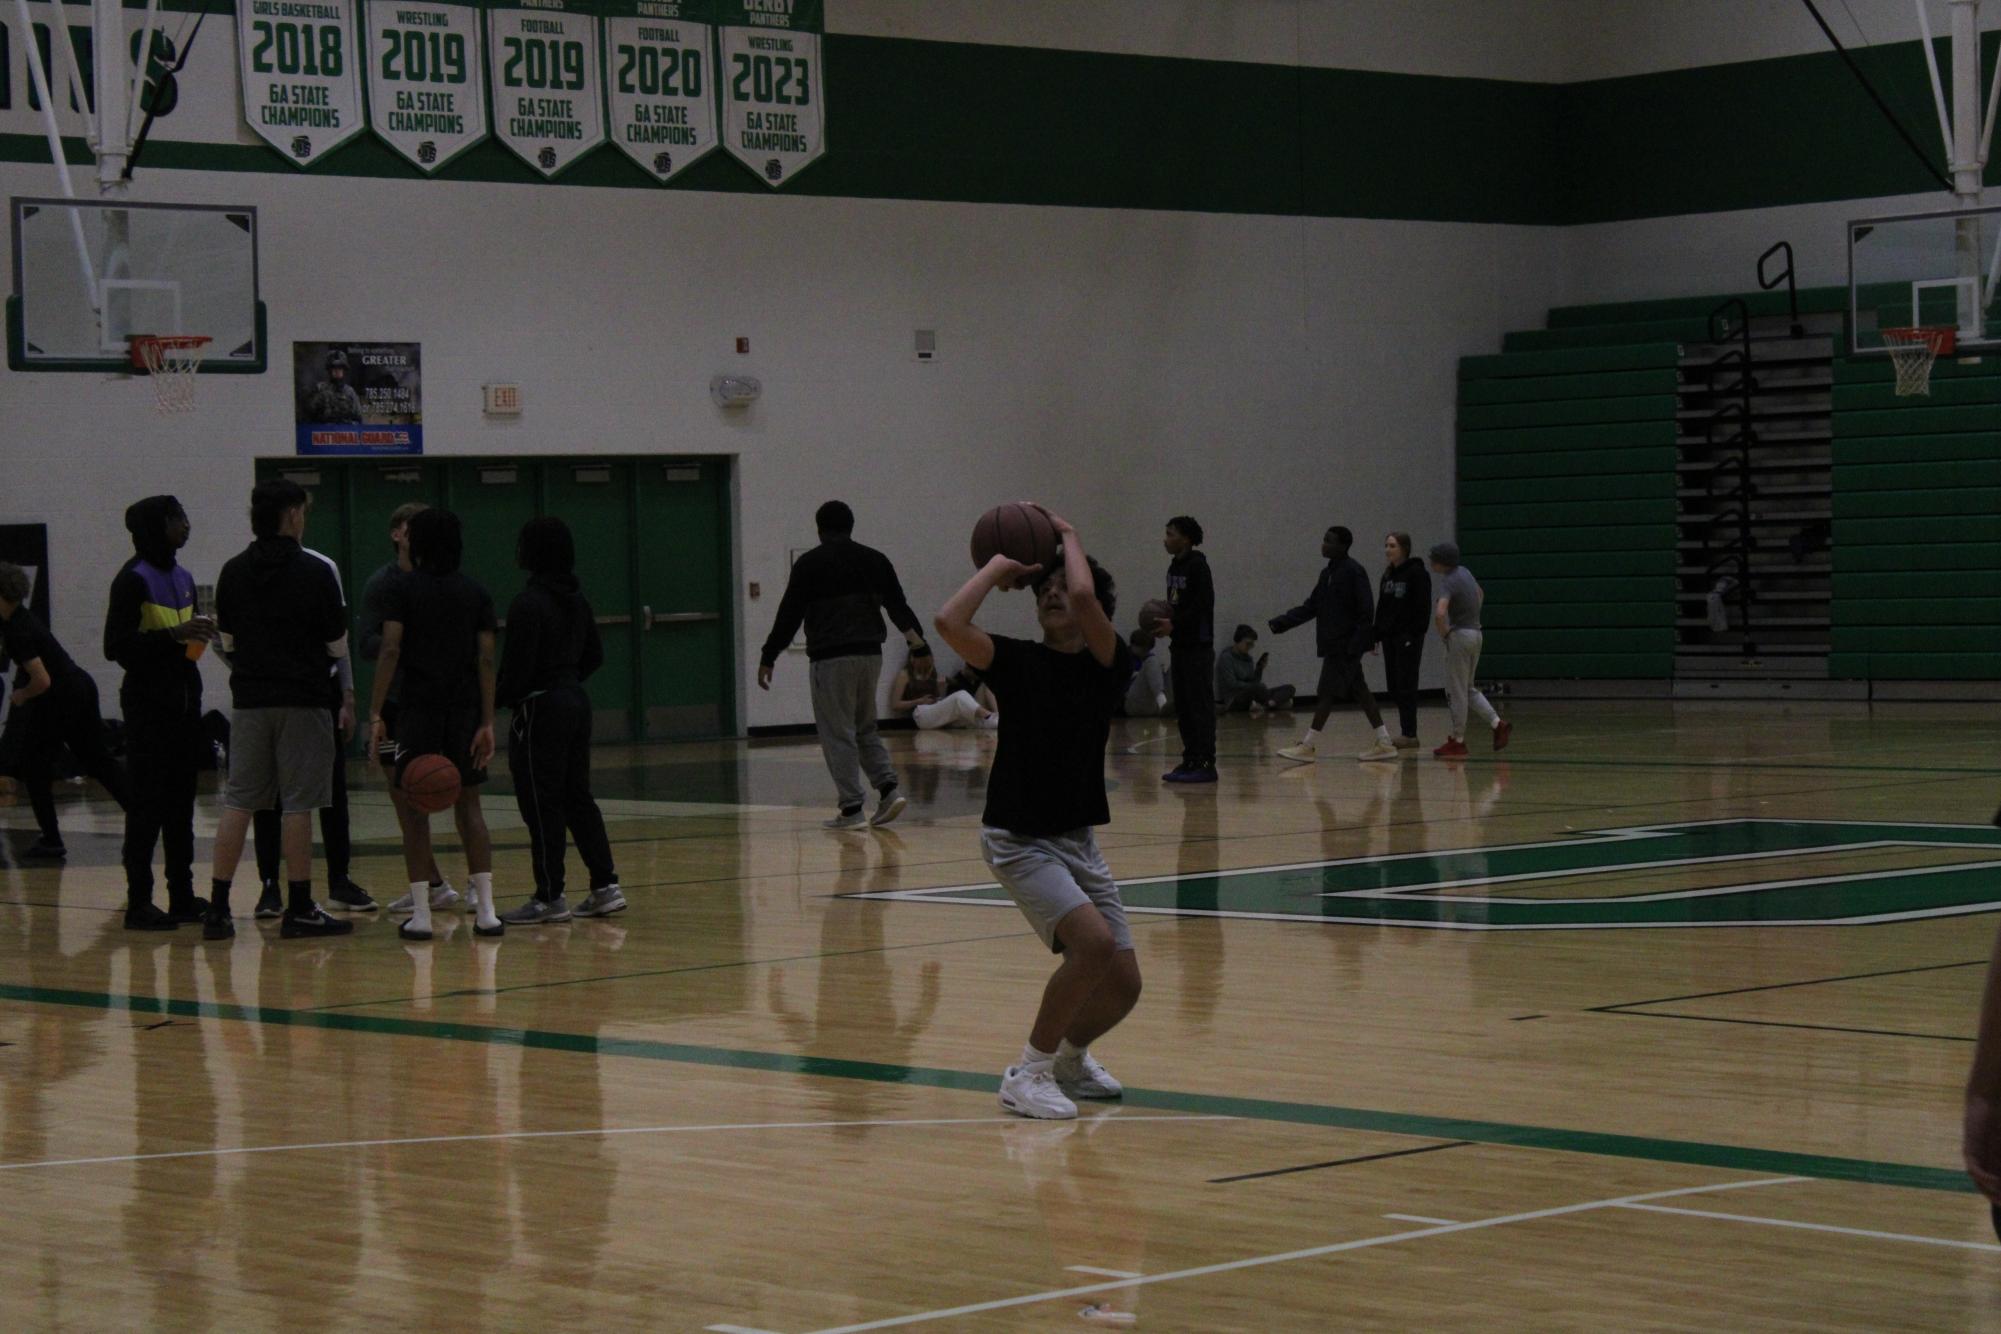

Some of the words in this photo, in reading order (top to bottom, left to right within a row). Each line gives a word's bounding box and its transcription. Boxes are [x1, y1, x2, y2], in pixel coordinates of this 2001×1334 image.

[253, 1, 279, 16] GIRLS
[281, 3, 341, 20] BASKETBALL
[397, 10, 449, 27] WRESTLING
[637, 2, 679, 17] PANTHERS
[749, 12, 790, 28] PANTHERS
[521, 19, 565, 35] FOOTBALL
[638, 27, 680, 43] FOOTBALL
[252, 20, 343, 77] 2018
[748, 36, 794, 52] WRESTLING
[381, 29, 467, 84] 2019
[504, 37, 584, 91] 2019
[618, 45, 701, 97] 2020
[733, 53, 810, 106] 2023
[269, 84, 289, 105] 6A
[292, 86, 329, 106] STATE
[396, 91, 416, 111] 6A
[418, 92, 454, 113] STATE
[261, 106, 340, 129] CHAMPIONS
[518, 97, 535, 118] 6A
[538, 99, 573, 119] STATE
[634, 105, 651, 123] 6A
[654, 105, 688, 125] STATE
[388, 112, 464, 135] CHAMPIONS
[510, 118, 583, 140] CHAMPIONS
[746, 111, 763, 130] 6A
[765, 113, 798, 133] STATE
[627, 124, 697, 146] CHAMPIONS
[741, 131, 807, 153] CHAMPIONS
[361, 355, 407, 366] GREATER
[494, 387, 517, 408] EXIT
[312, 431, 358, 446] NATIONAL
